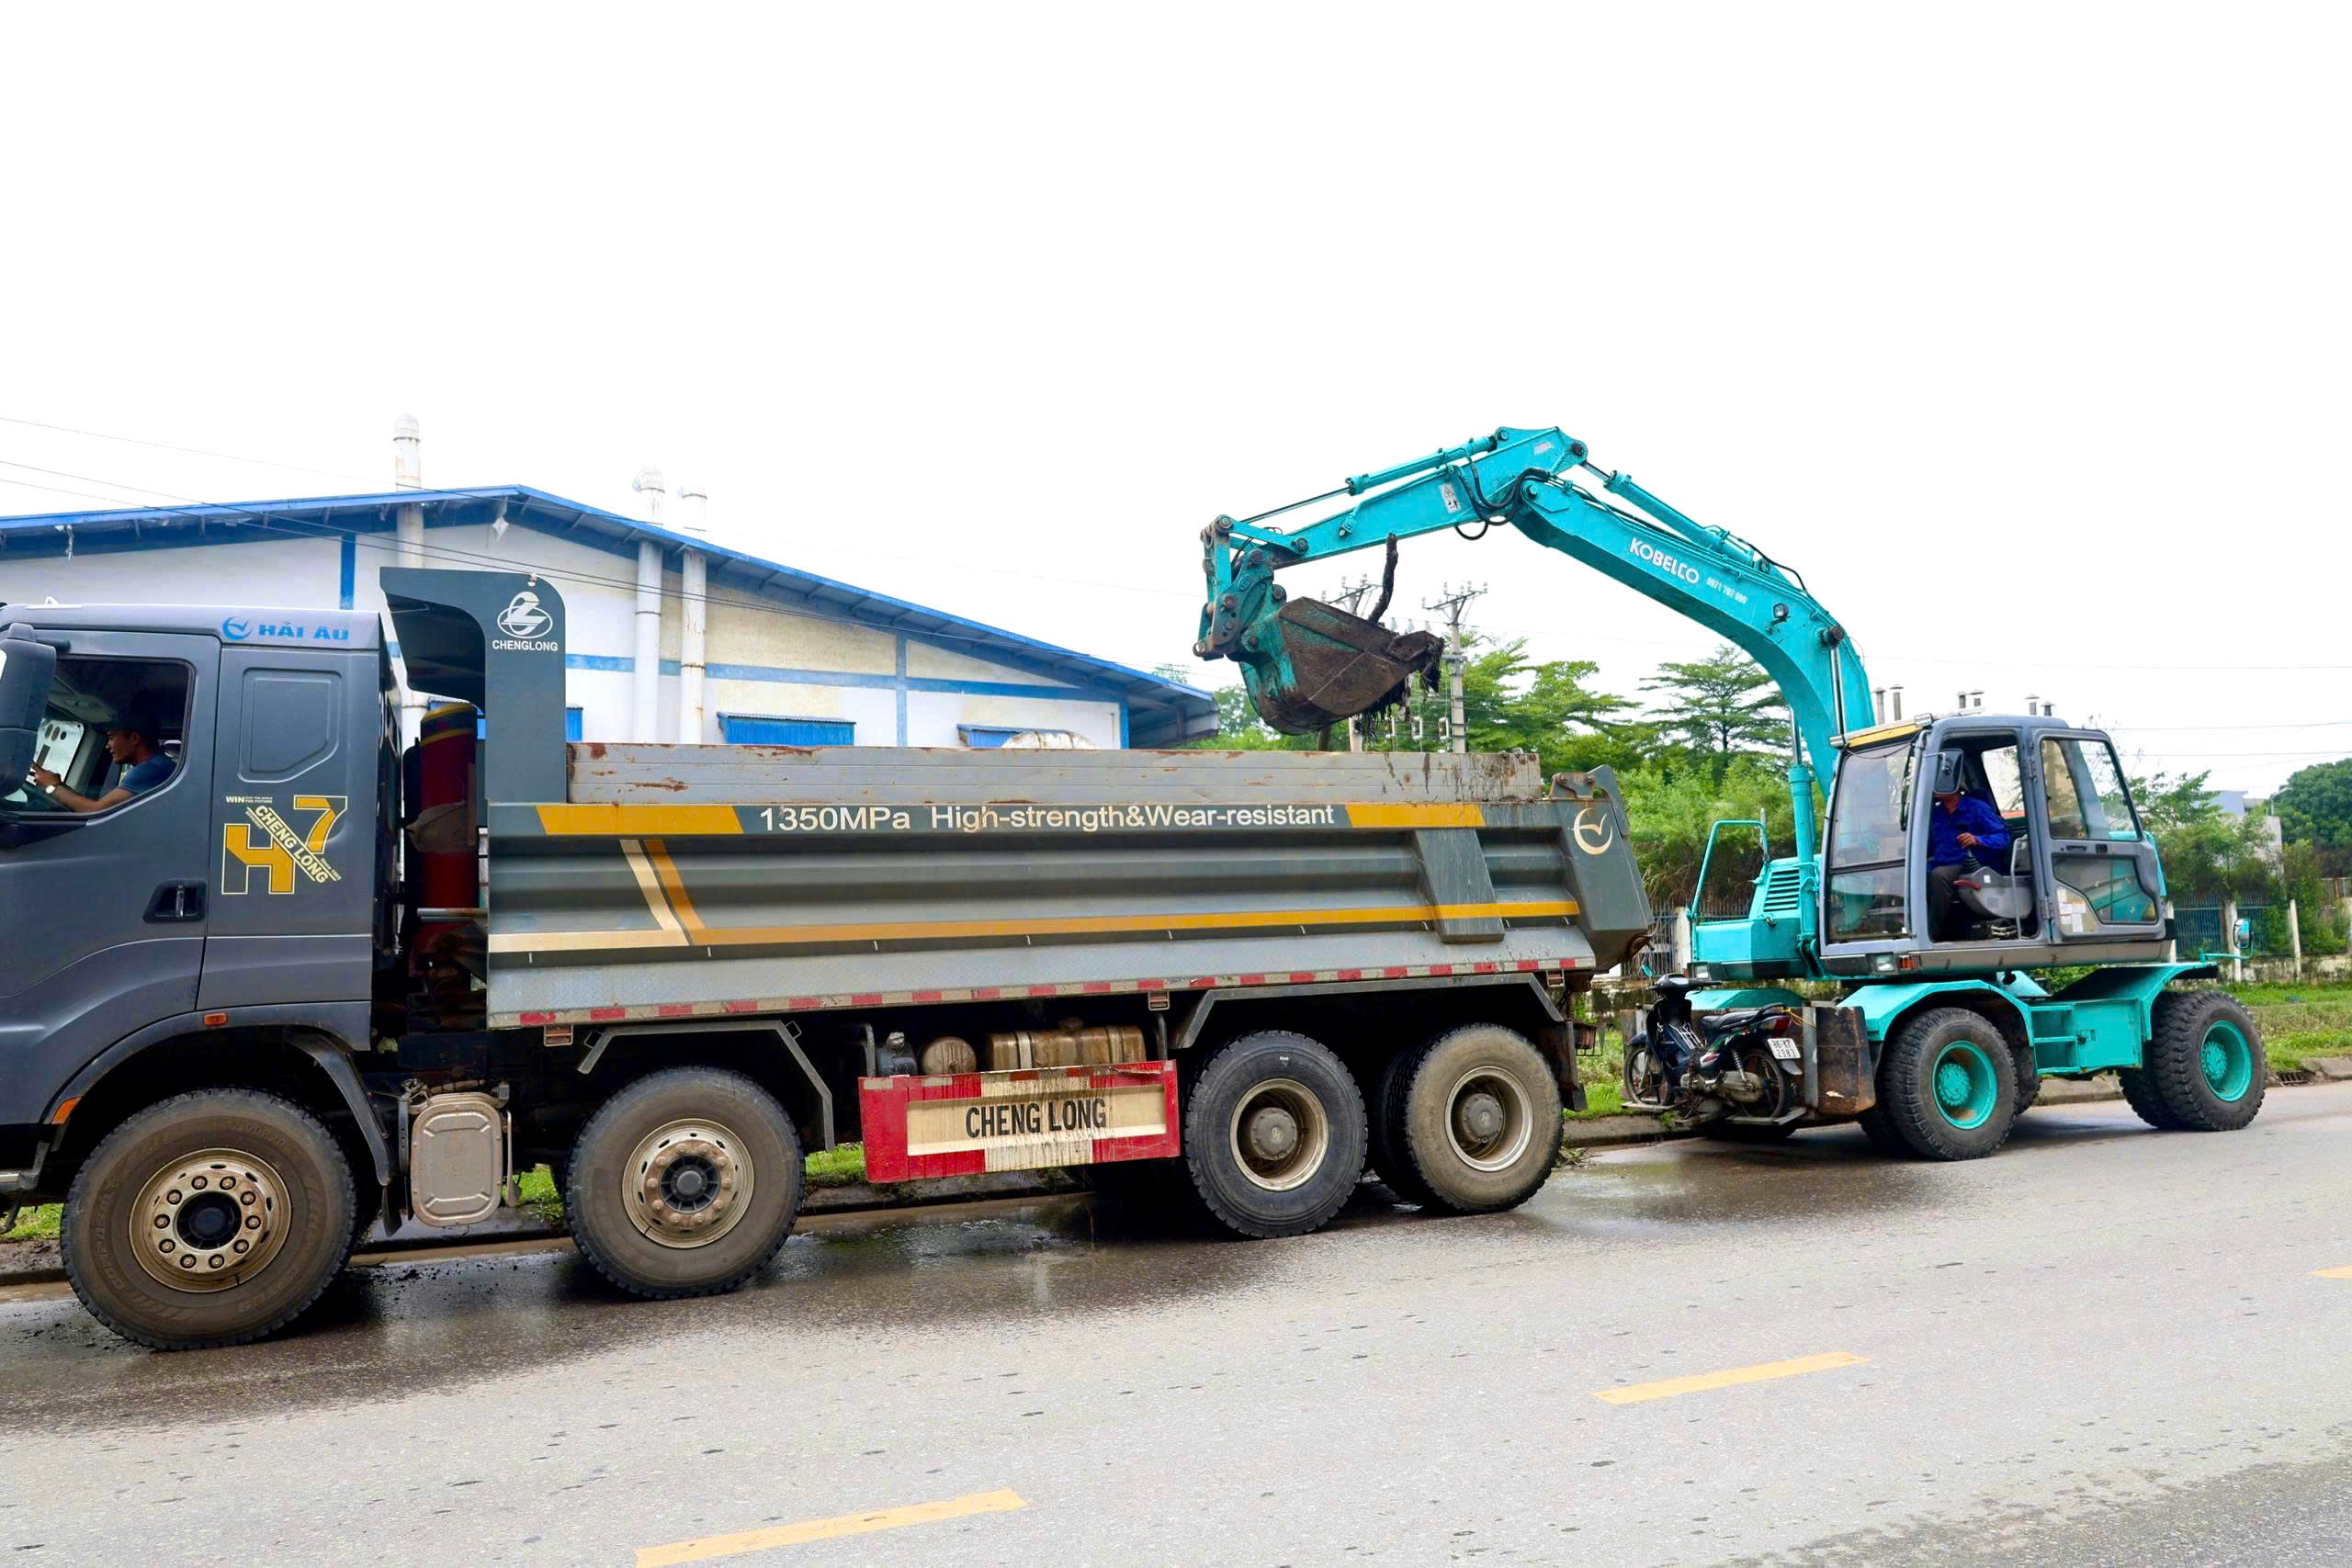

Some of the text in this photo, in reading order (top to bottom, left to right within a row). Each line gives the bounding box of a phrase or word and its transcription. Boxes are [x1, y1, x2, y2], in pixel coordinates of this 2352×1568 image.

[1630, 537, 1699, 584] KOBELCO
[492, 640, 559, 651] CHENGLONG
[760, 807, 910, 831] 1350MPa
[255, 806, 297, 849] CHENG
[294, 847, 329, 883] LONG
[966, 1098, 1107, 1138] CHENG LONG
